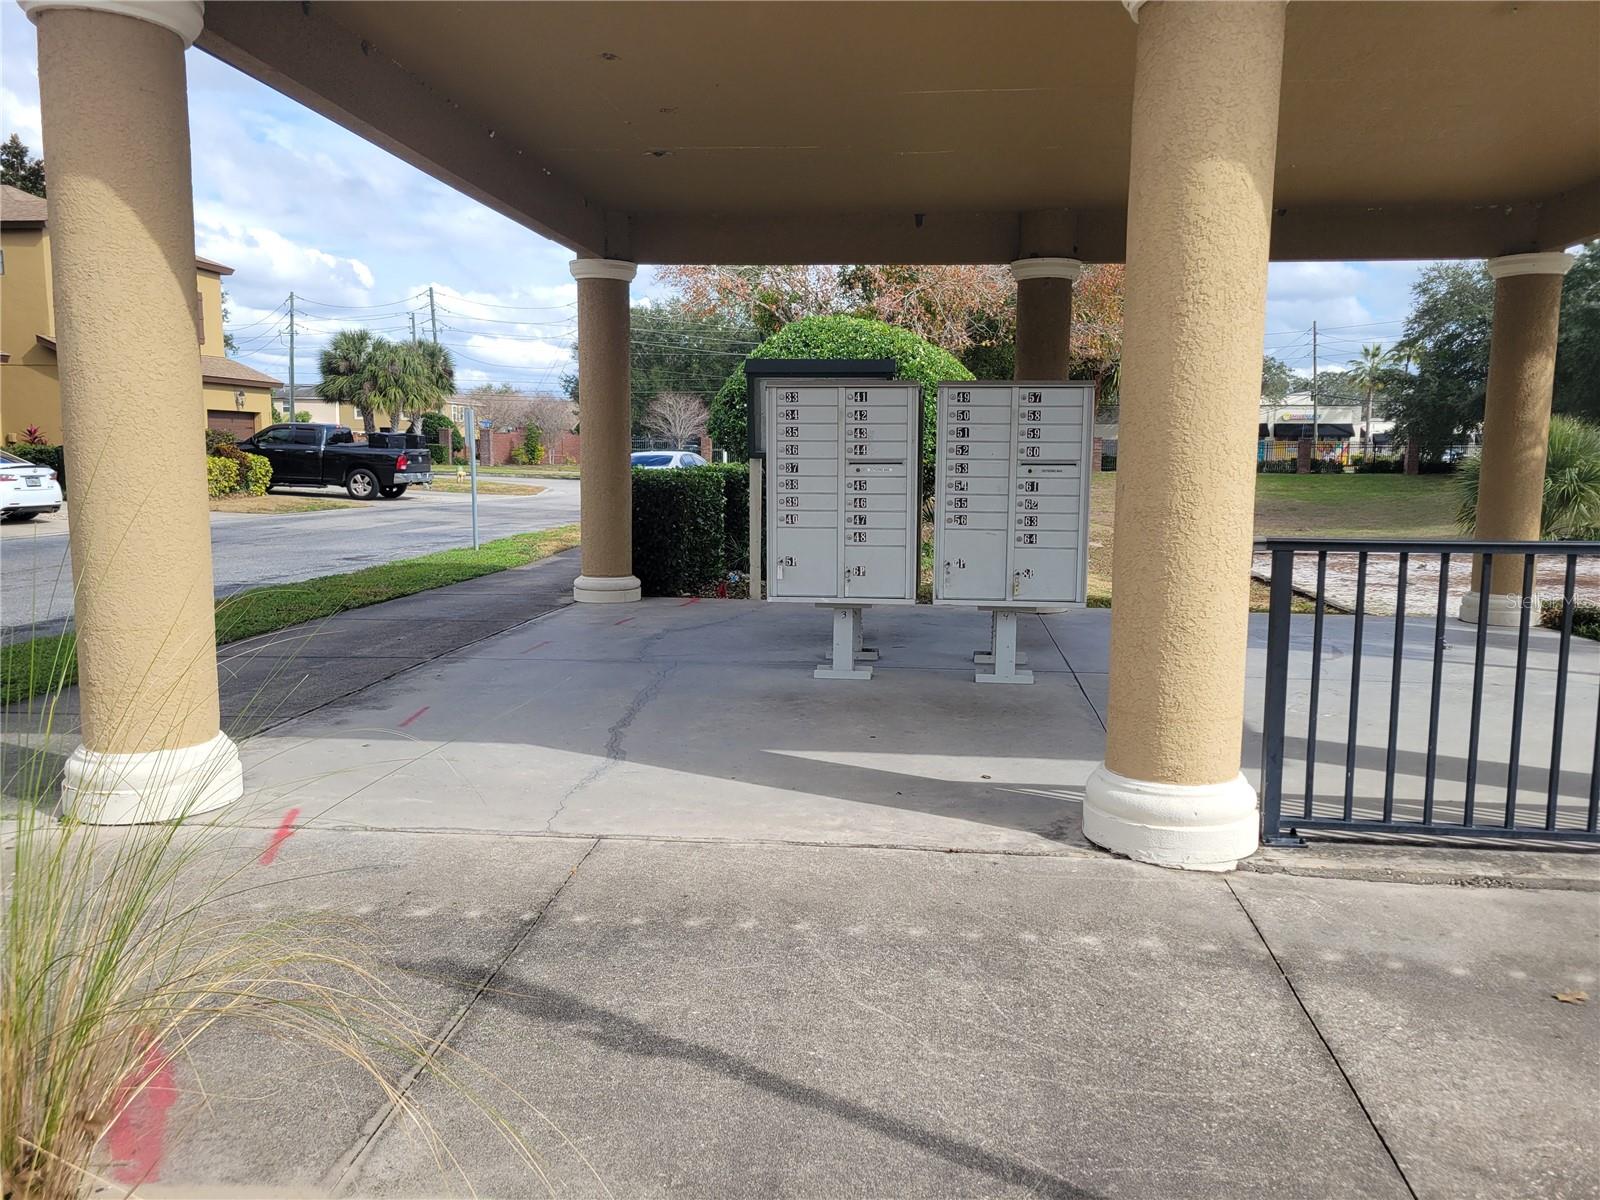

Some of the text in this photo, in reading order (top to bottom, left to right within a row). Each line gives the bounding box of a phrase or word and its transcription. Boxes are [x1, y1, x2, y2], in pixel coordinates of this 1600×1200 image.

[786, 392, 798, 402] 33
[855, 392, 867, 402] 41
[957, 392, 970, 402] 49
[1028, 392, 1041, 403] 57
[786, 410, 798, 420] 34
[855, 410, 867, 420] 42
[957, 410, 970, 420] 50
[1028, 410, 1041, 420] 58
[786, 427, 798, 437] 35
[854, 428, 867, 438] 43
[956, 428, 969, 438] 51
[1027, 429, 1040, 439] 59
[786, 445, 798, 455] 36
[854, 445, 867, 455] 44
[956, 445, 969, 455] 52
[1027, 447, 1039, 457] 60
[786, 463, 798, 473] 37
[955, 463, 968, 473] 53
[786, 480, 798, 489] 38
[854, 480, 867, 490] 45
[955, 481, 968, 491] 54
[1025, 482, 1038, 492] 61
[786, 497, 798, 507] 39
[854, 498, 867, 508] 46
[955, 498, 967, 508] 55
[1025, 499, 1038, 509] 62
[786, 514, 798, 524] 40
[854, 515, 866, 525] 47
[954, 515, 967, 525] 56
[1024, 516, 1037, 526] 63
[854, 532, 866, 542] 48
[1024, 534, 1037, 544] 64
[853, 567, 865, 576] 6P
